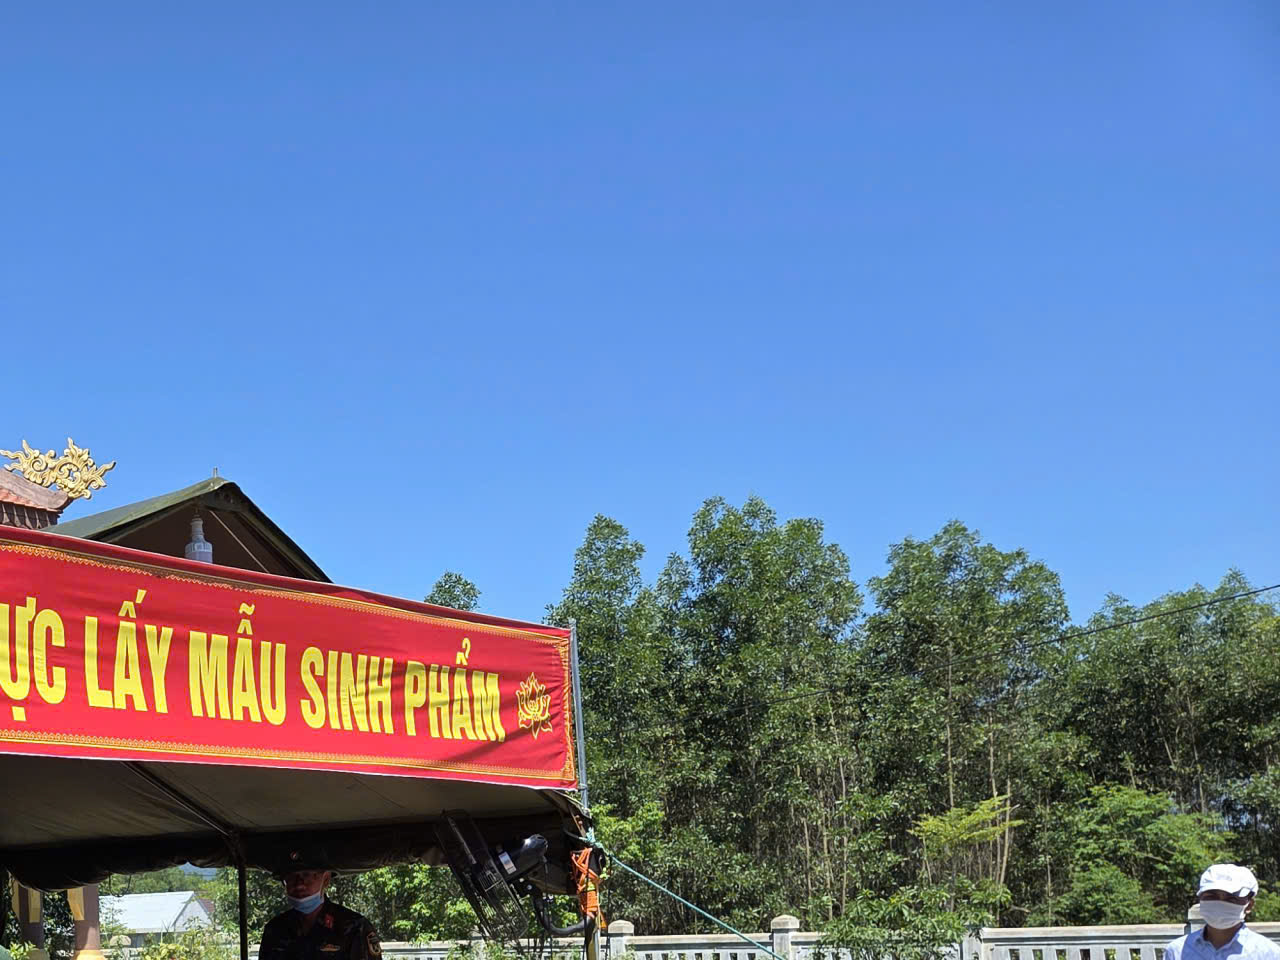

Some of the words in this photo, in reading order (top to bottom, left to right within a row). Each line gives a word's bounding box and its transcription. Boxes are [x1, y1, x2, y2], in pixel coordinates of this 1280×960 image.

[85, 589, 173, 713] LẤY
[189, 603, 286, 725] MẪU
[300, 647, 394, 734] SINH
[404, 638, 505, 742] PHẨM
